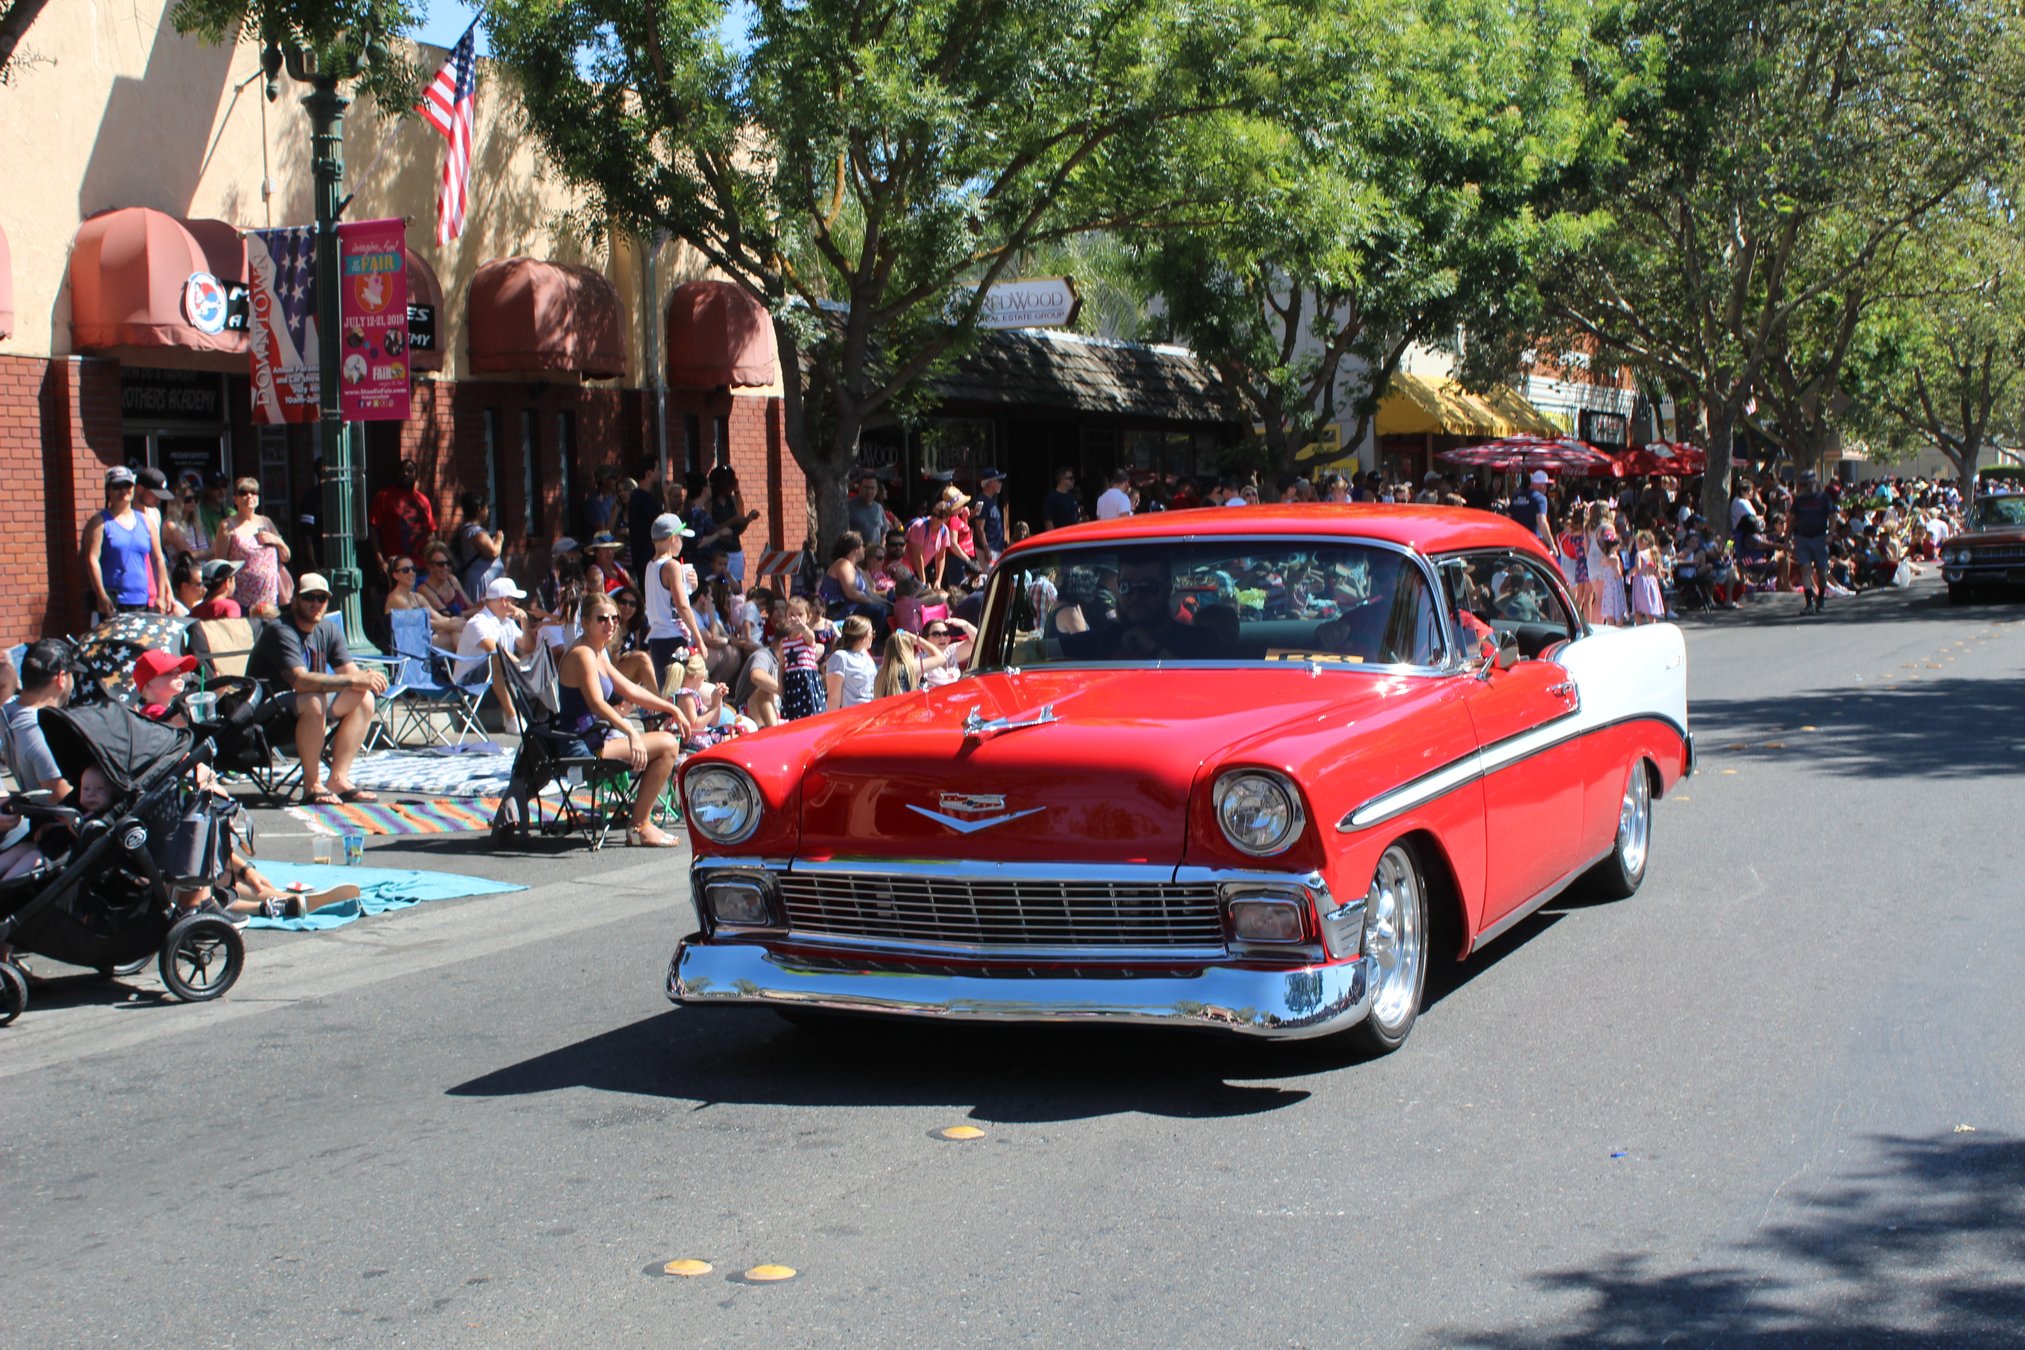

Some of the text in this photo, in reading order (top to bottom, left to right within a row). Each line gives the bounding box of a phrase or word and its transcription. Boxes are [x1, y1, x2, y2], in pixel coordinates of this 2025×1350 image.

[361, 255, 394, 273] FAIR
[344, 316, 366, 328] JULY
[387, 314, 404, 326] 2019
[1002, 312, 1032, 322] ESTATE
[1035, 311, 1064, 321] GROUP
[253, 253, 270, 406] DOWNTOWN
[169, 388, 216, 413] ACADEMY
